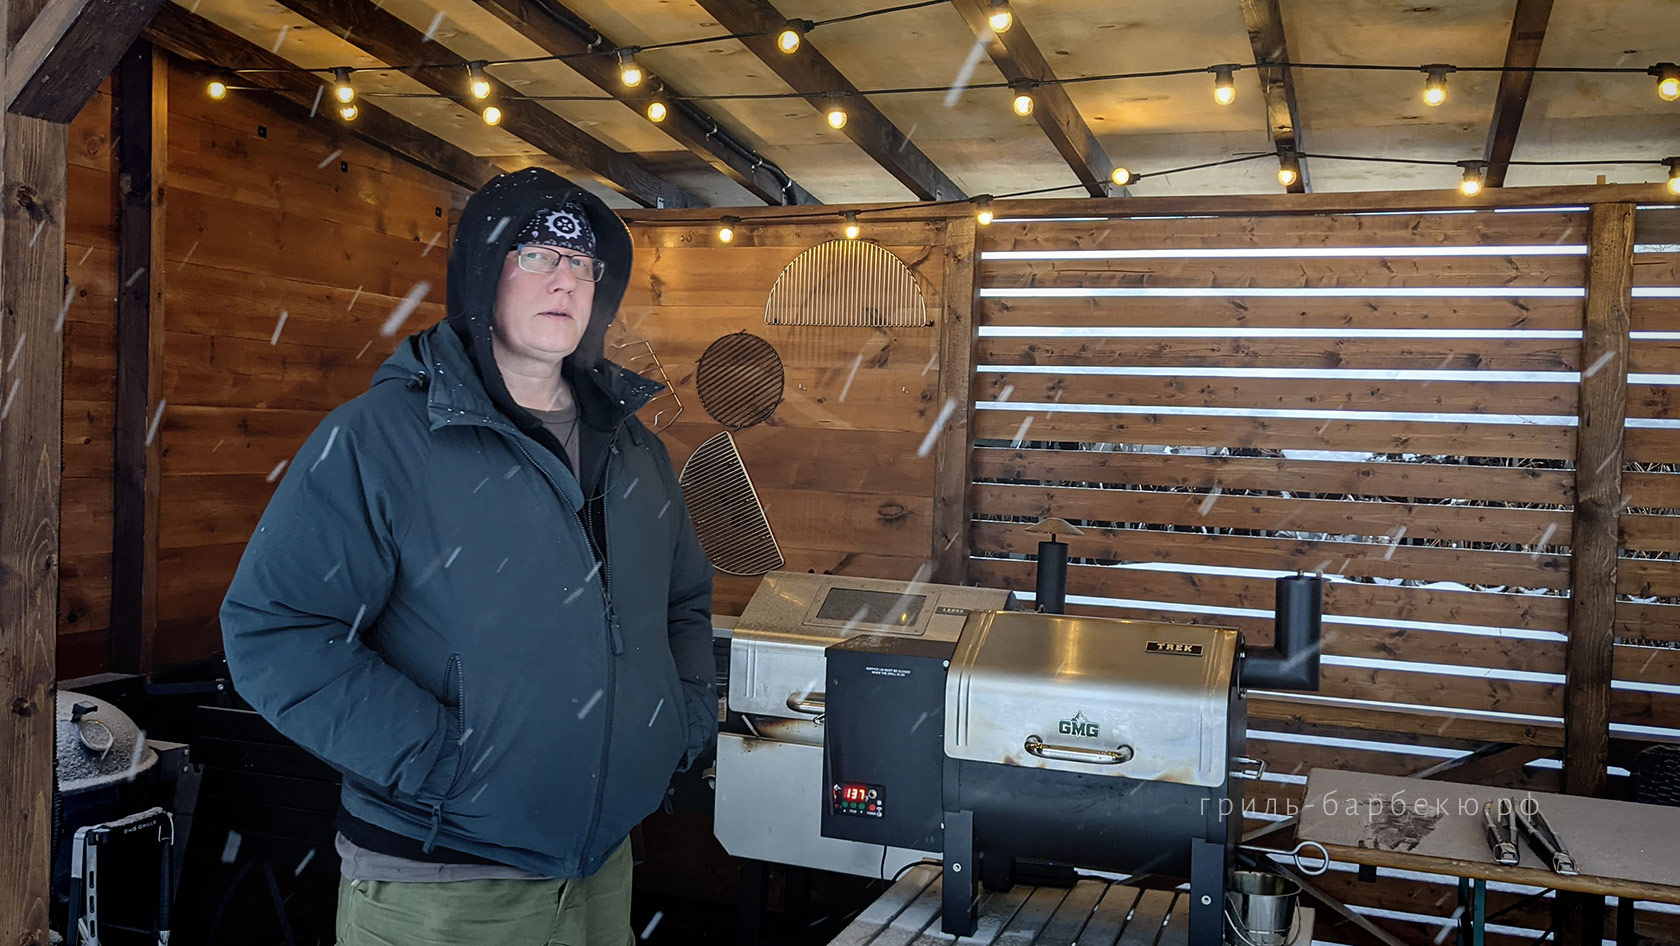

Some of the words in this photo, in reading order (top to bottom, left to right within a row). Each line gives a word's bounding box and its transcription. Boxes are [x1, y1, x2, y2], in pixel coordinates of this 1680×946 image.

[1157, 643, 1193, 652] TREK
[1058, 720, 1099, 737] GMG
[847, 788, 865, 800] 137
